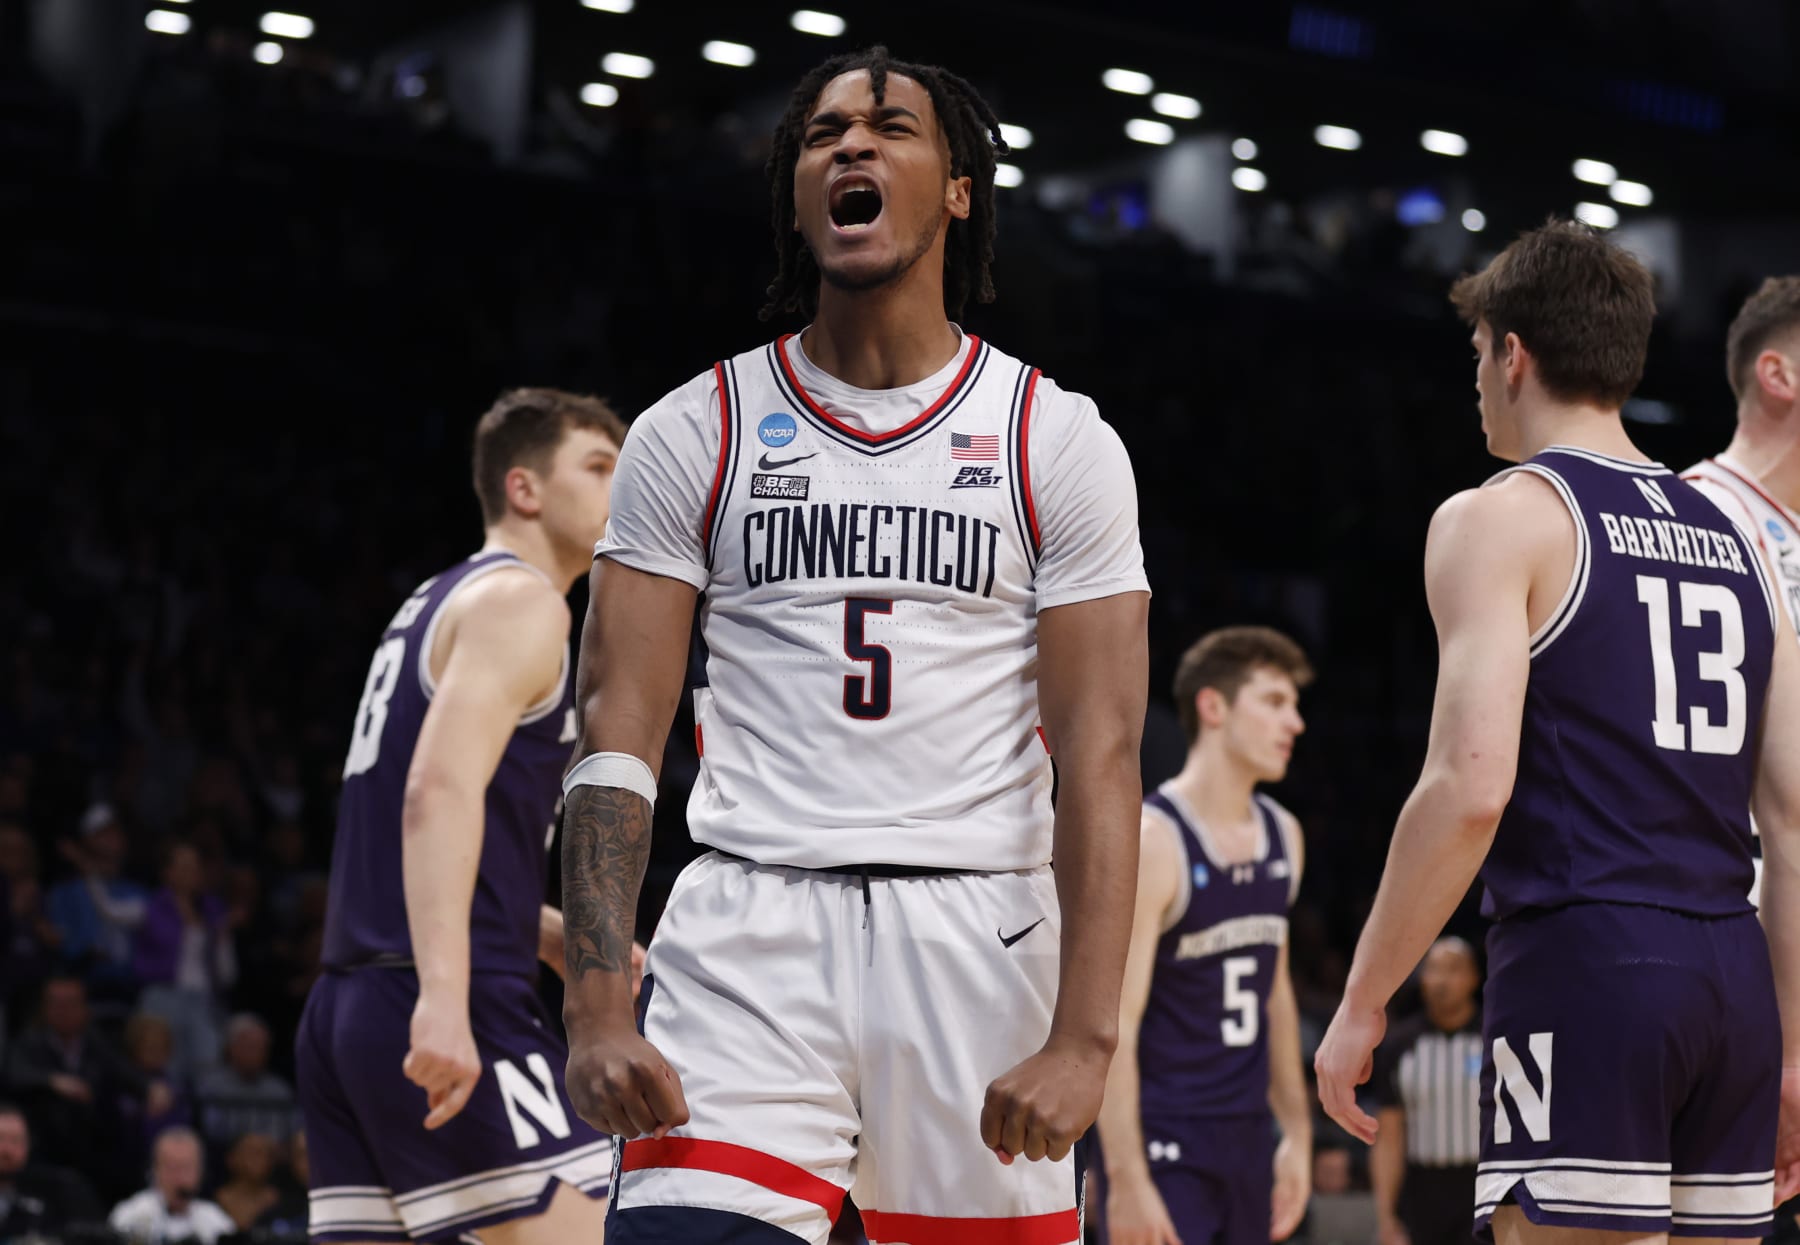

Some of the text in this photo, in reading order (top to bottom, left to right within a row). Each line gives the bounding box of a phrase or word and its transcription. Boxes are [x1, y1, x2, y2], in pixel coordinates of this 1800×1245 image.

[763, 428, 794, 438] NCAA
[958, 466, 994, 476] BIG
[753, 487, 807, 497] CHANGE
[953, 475, 1004, 485] EAST
[1632, 477, 1676, 517] N
[743, 504, 1001, 598] CONNECTICUT
[1599, 512, 1748, 576] BARNHIZER
[842, 596, 893, 721] 5
[1636, 574, 1747, 755] 13
[1220, 956, 1258, 1047] 5
[493, 1052, 572, 1150] N
[1492, 1031, 1554, 1145] N
